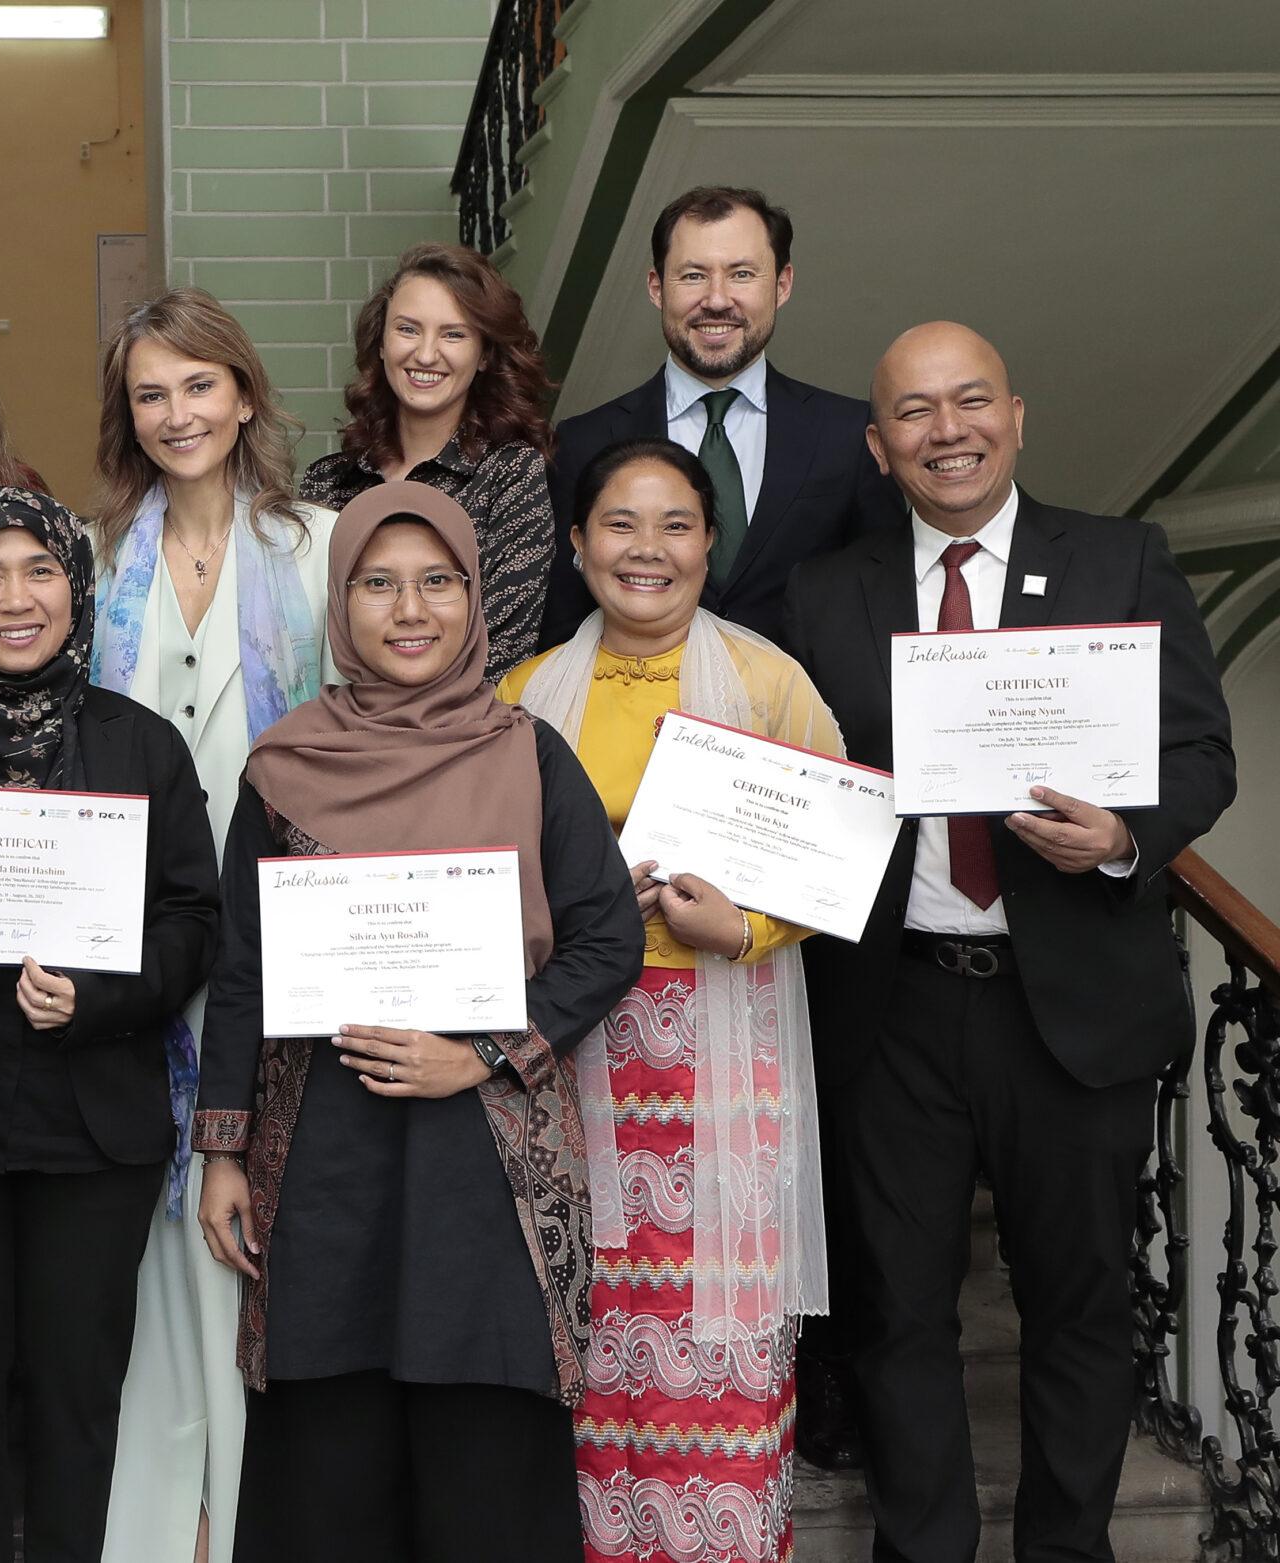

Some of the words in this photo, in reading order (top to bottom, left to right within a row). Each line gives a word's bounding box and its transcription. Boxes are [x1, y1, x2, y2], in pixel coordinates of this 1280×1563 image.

[907, 644, 988, 663] InteRussia
[1109, 643, 1137, 651] REA
[985, 677, 1069, 691] CERTIFICATE
[988, 708, 1007, 717] Win
[1010, 708, 1036, 718] Naing
[1038, 707, 1065, 717] Nyunt
[672, 726, 745, 760] InteRussia
[733, 780, 810, 810] CERTIFICATE
[858, 785, 885, 799] REA
[99, 812, 125, 820] REA
[735, 806, 752, 818] Win
[754, 812, 771, 823] Win
[9, 865, 30, 874] Binti
[32, 867, 65, 876] Hashim
[273, 870, 348, 888] InteRussia
[348, 902, 428, 915] CERTIFICATE
[349, 933, 377, 941] Silvira
[397, 931, 429, 939] Rosalia
